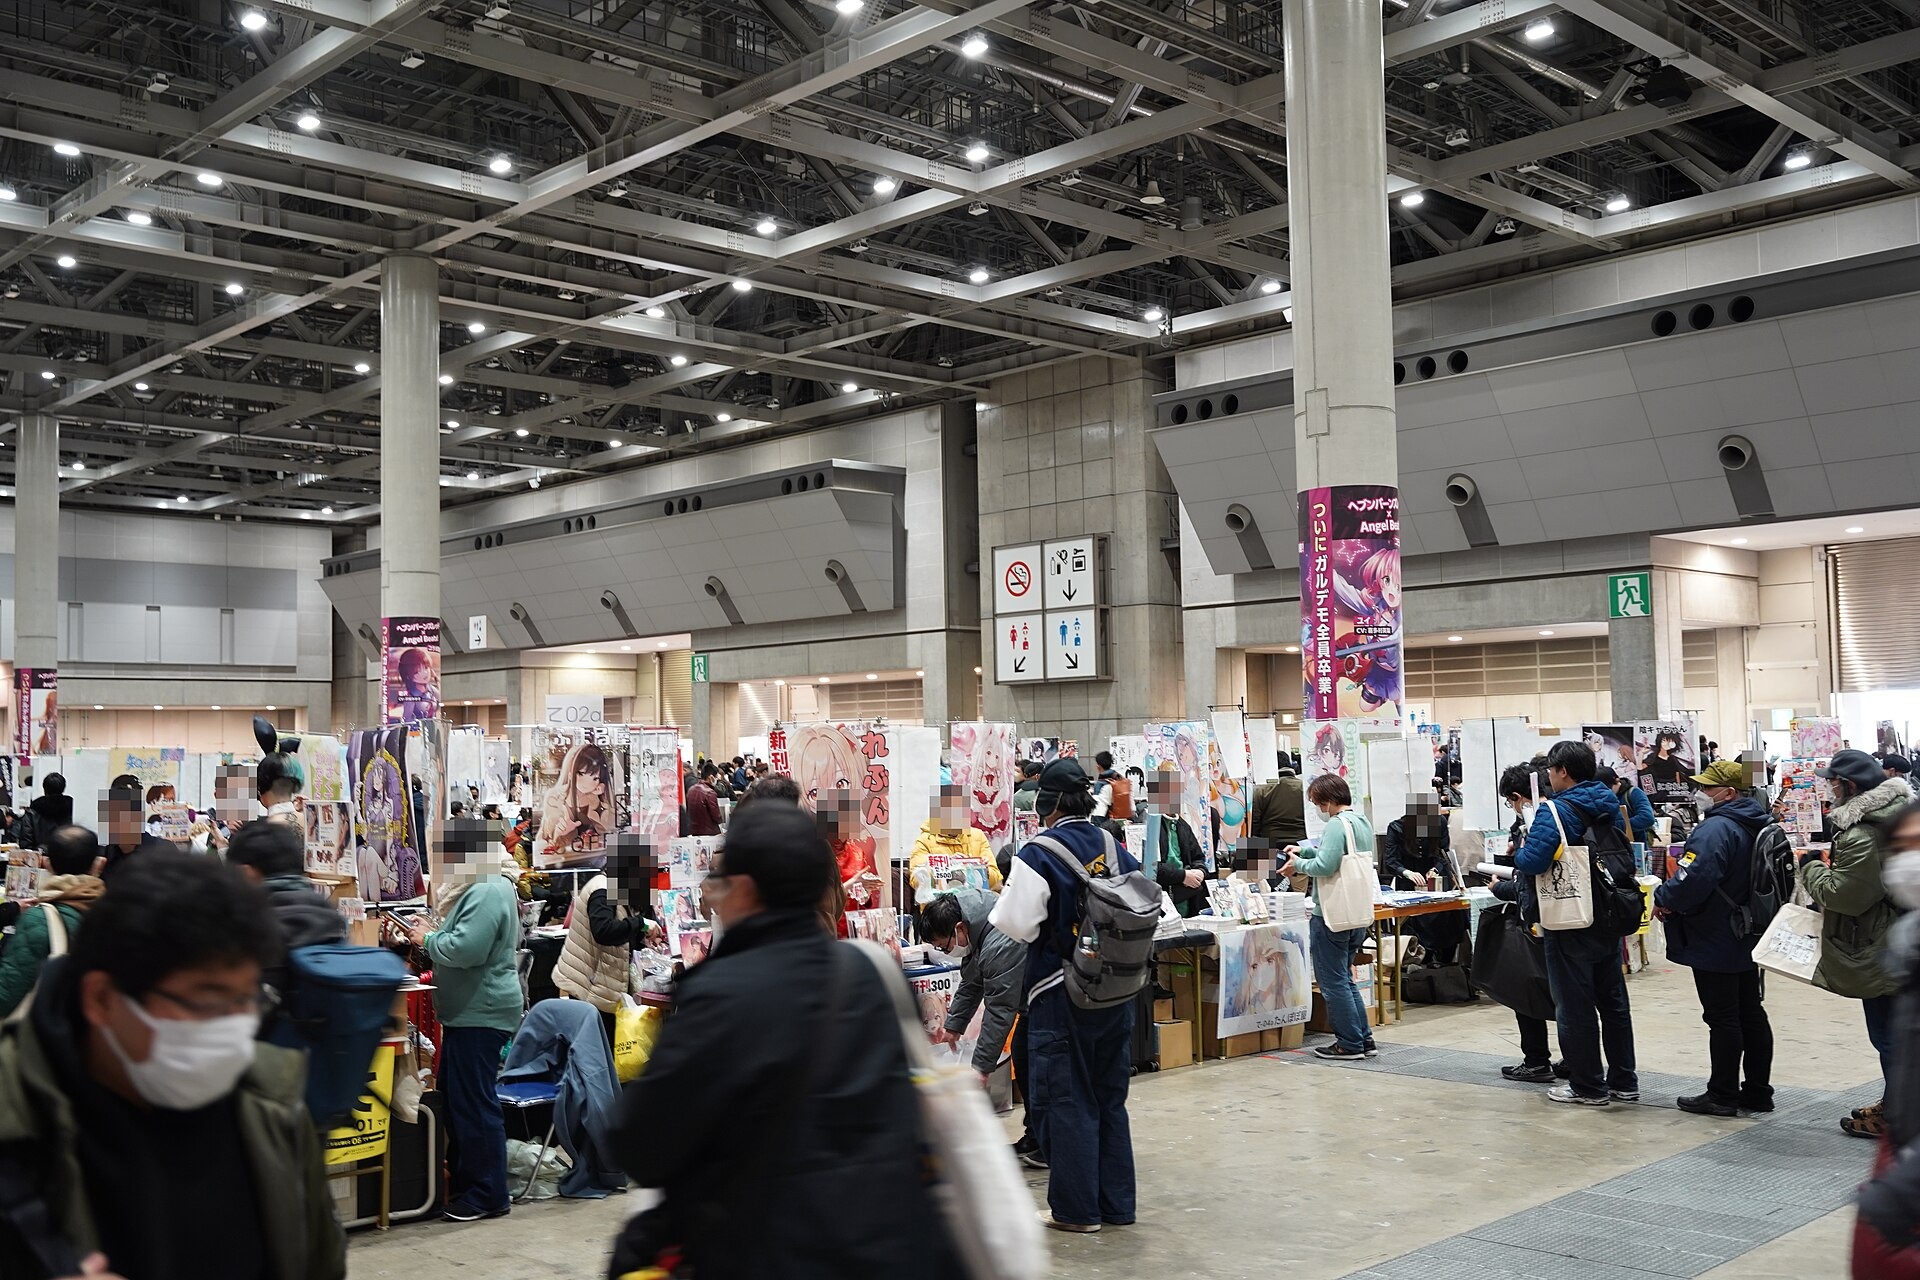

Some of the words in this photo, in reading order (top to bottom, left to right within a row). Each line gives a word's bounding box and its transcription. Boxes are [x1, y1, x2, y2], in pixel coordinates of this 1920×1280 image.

[1360, 520, 1389, 534] Angel
[402, 635, 422, 645] Angel
[769, 730, 789, 770] 新刊
[861, 731, 889, 825] れぶん
[929, 855, 949, 867] 新刊
